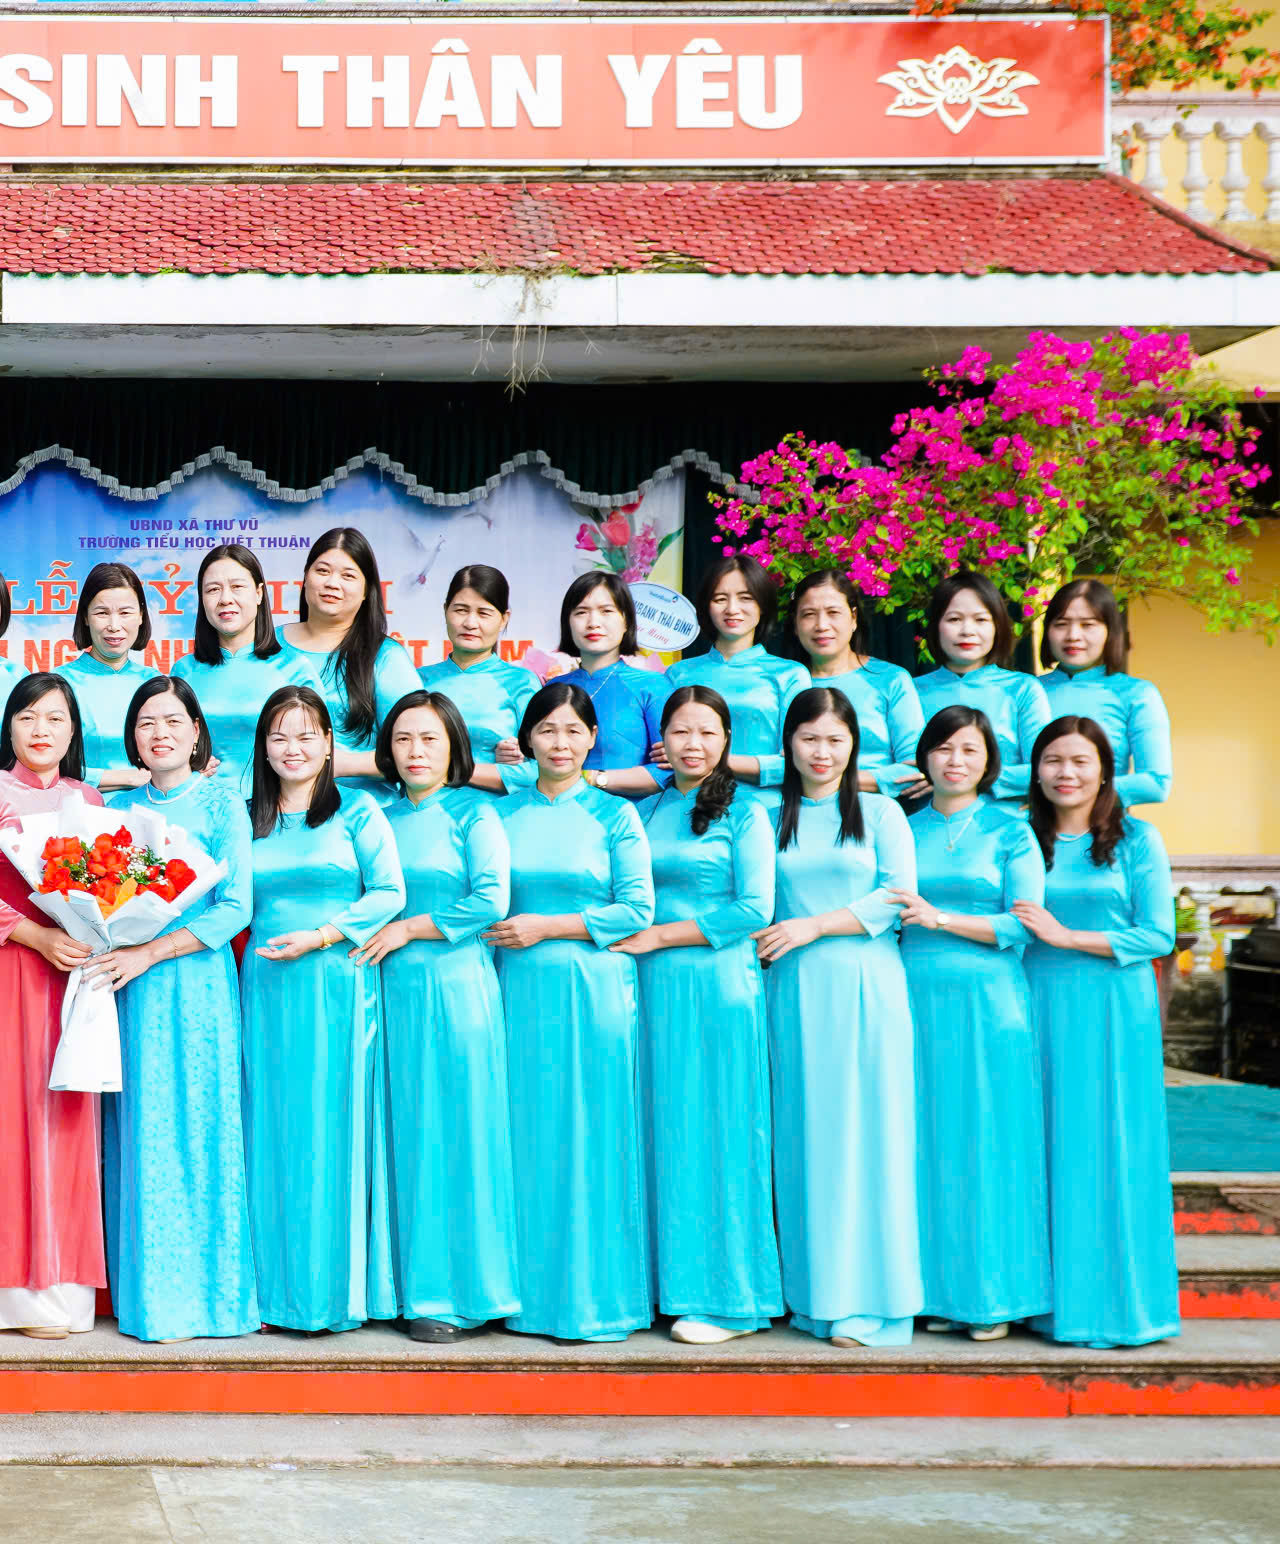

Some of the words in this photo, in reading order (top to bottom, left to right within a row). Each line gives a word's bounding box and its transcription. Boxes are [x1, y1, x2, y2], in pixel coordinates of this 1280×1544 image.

[282, 37, 563, 128] THÂN
[607, 37, 803, 130] YÊU
[130, 519, 173, 531] UBND
[178, 517, 200, 531] XÃ
[204, 518, 236, 531] THƯ
[79, 534, 141, 548] TRƯỜNG
[145, 532, 179, 548] TIỂU
[184, 536, 216, 550] HỌC
[258, 535, 311, 550] THUẬN
